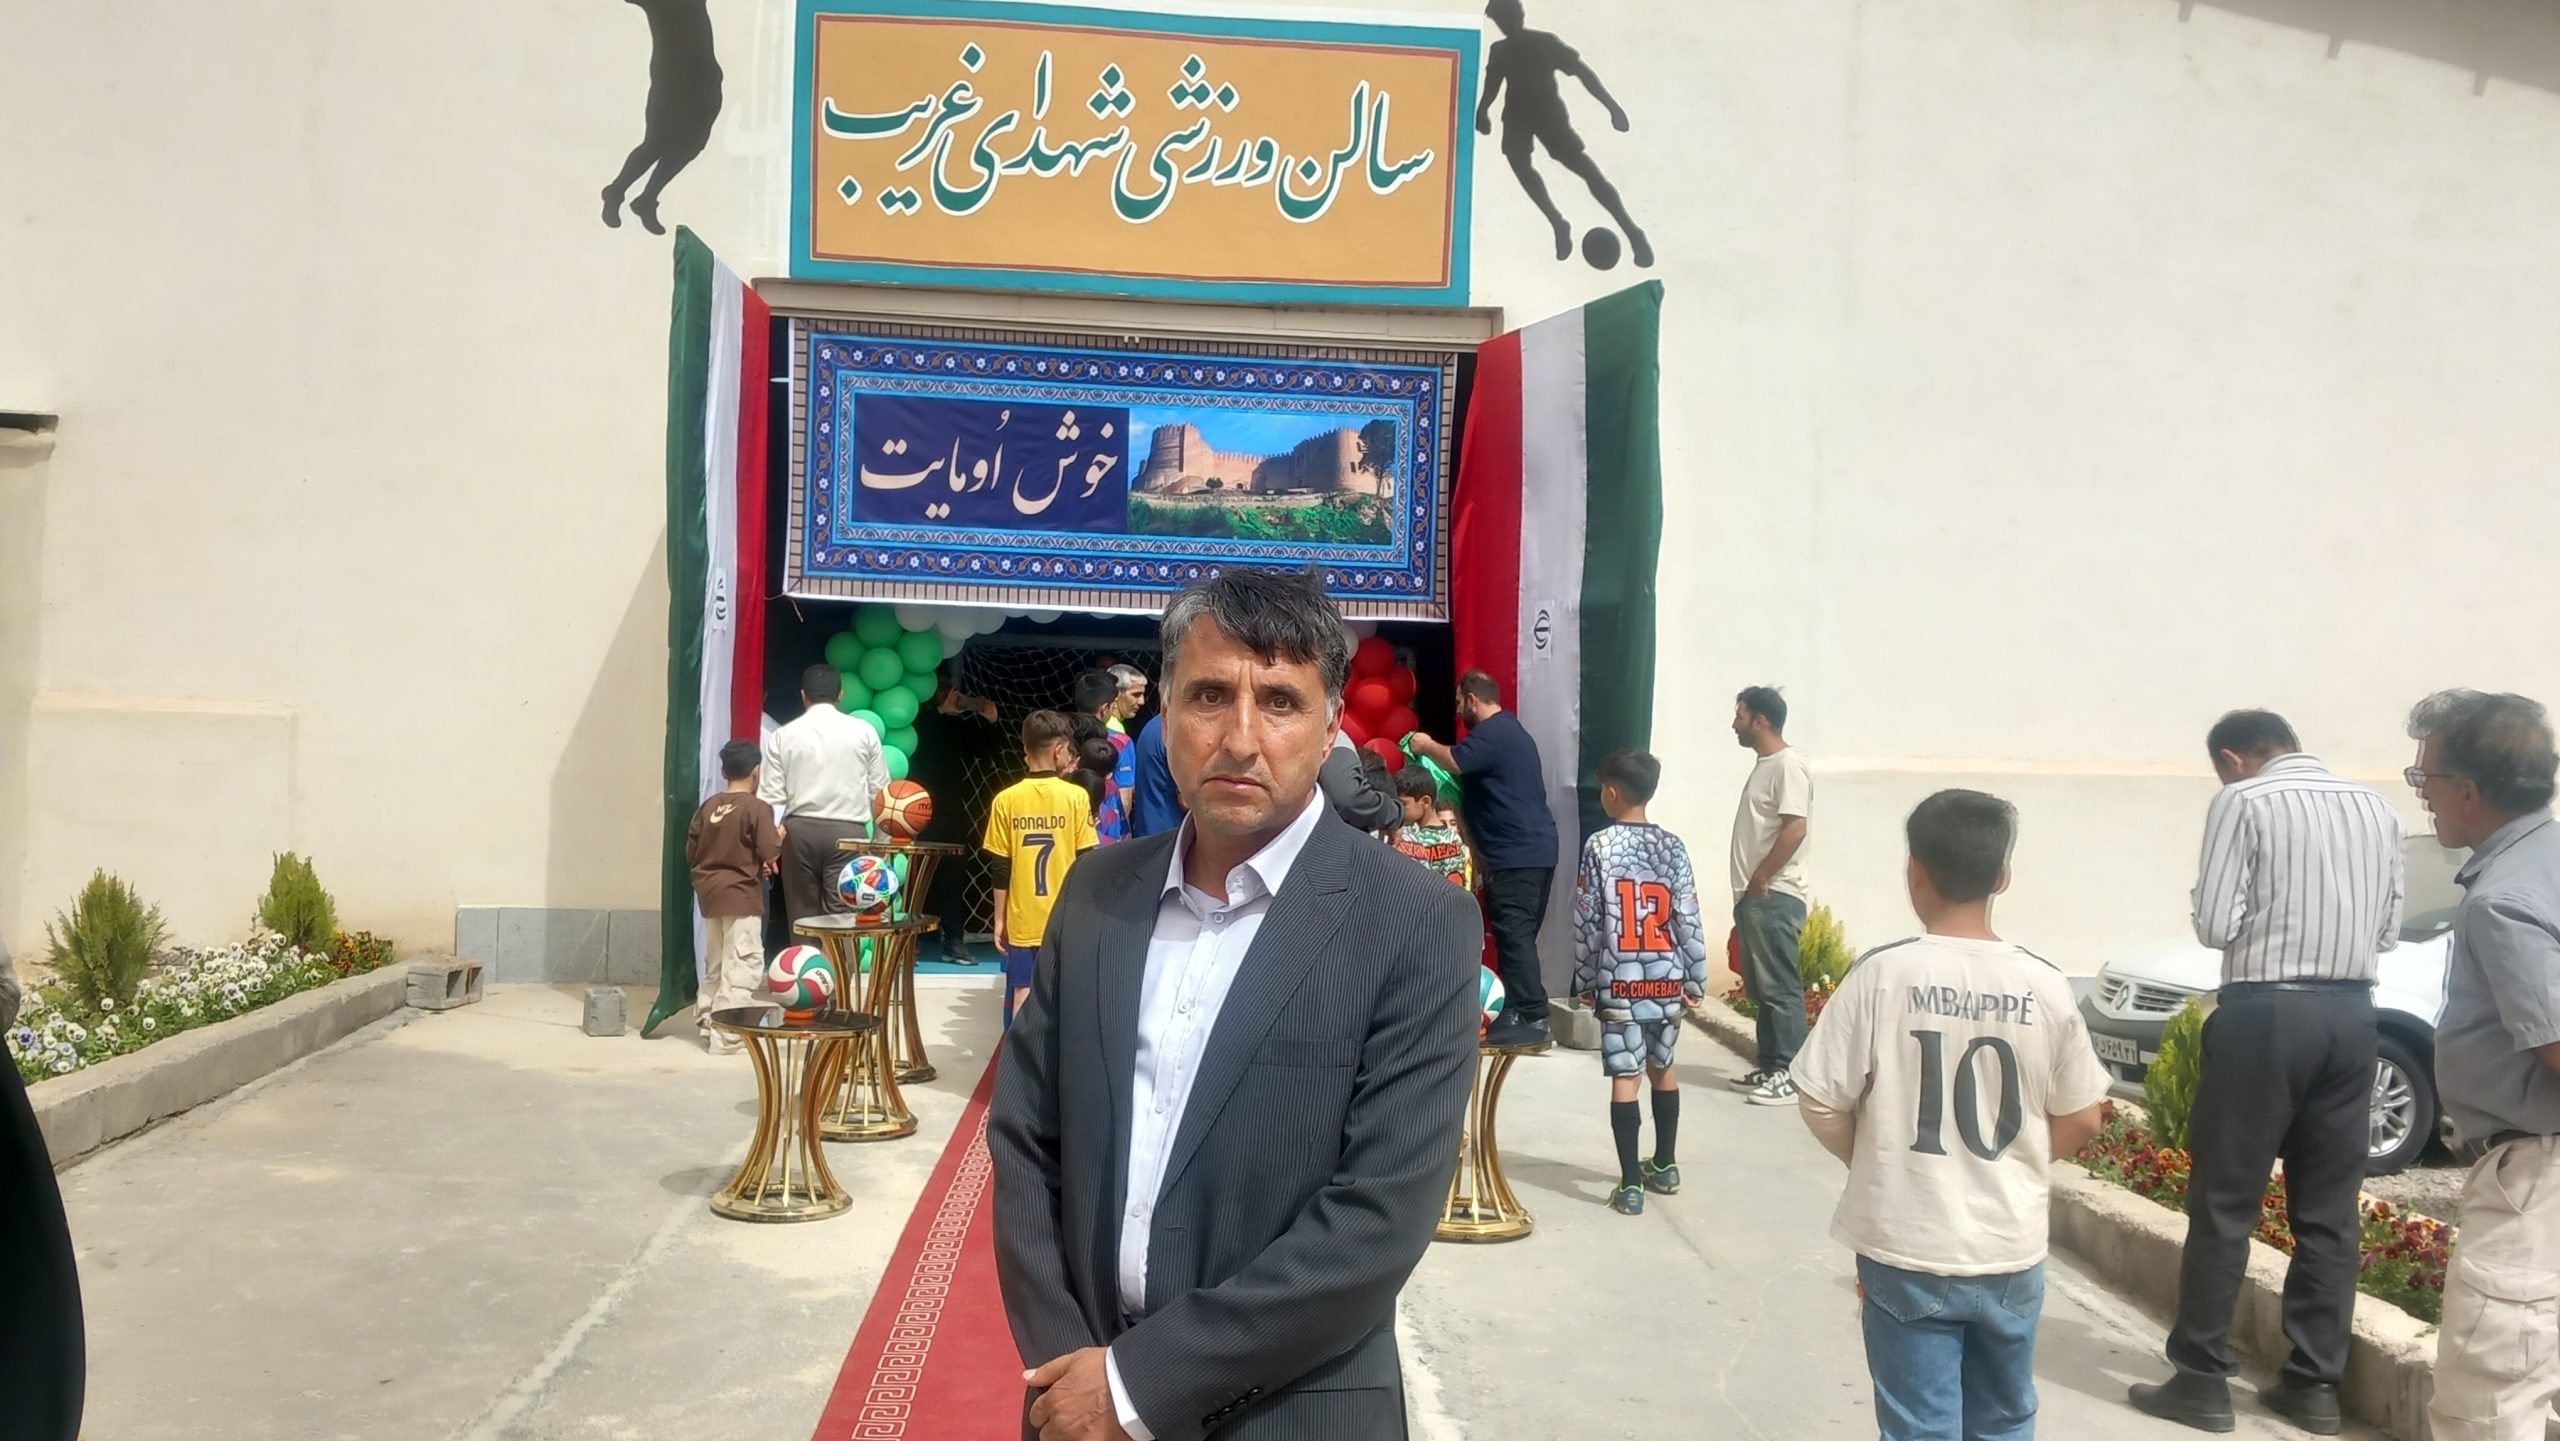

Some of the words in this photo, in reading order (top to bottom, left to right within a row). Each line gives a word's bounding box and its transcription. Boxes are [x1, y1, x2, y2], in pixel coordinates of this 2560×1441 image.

[822, 42, 985, 216] غریب
[931, 50, 1134, 216] شهدای
[1111, 54, 1279, 223] ورزشی
[1277, 80, 1433, 222] سالن
[1013, 411, 1119, 515] خوش
[1013, 816, 1066, 830] RONALDO
[1022, 833, 1056, 896] 7
[1616, 879, 1673, 952] 12
[1908, 986, 2034, 1026] MBAPPÉ
[1909, 1030, 2022, 1161] 10
